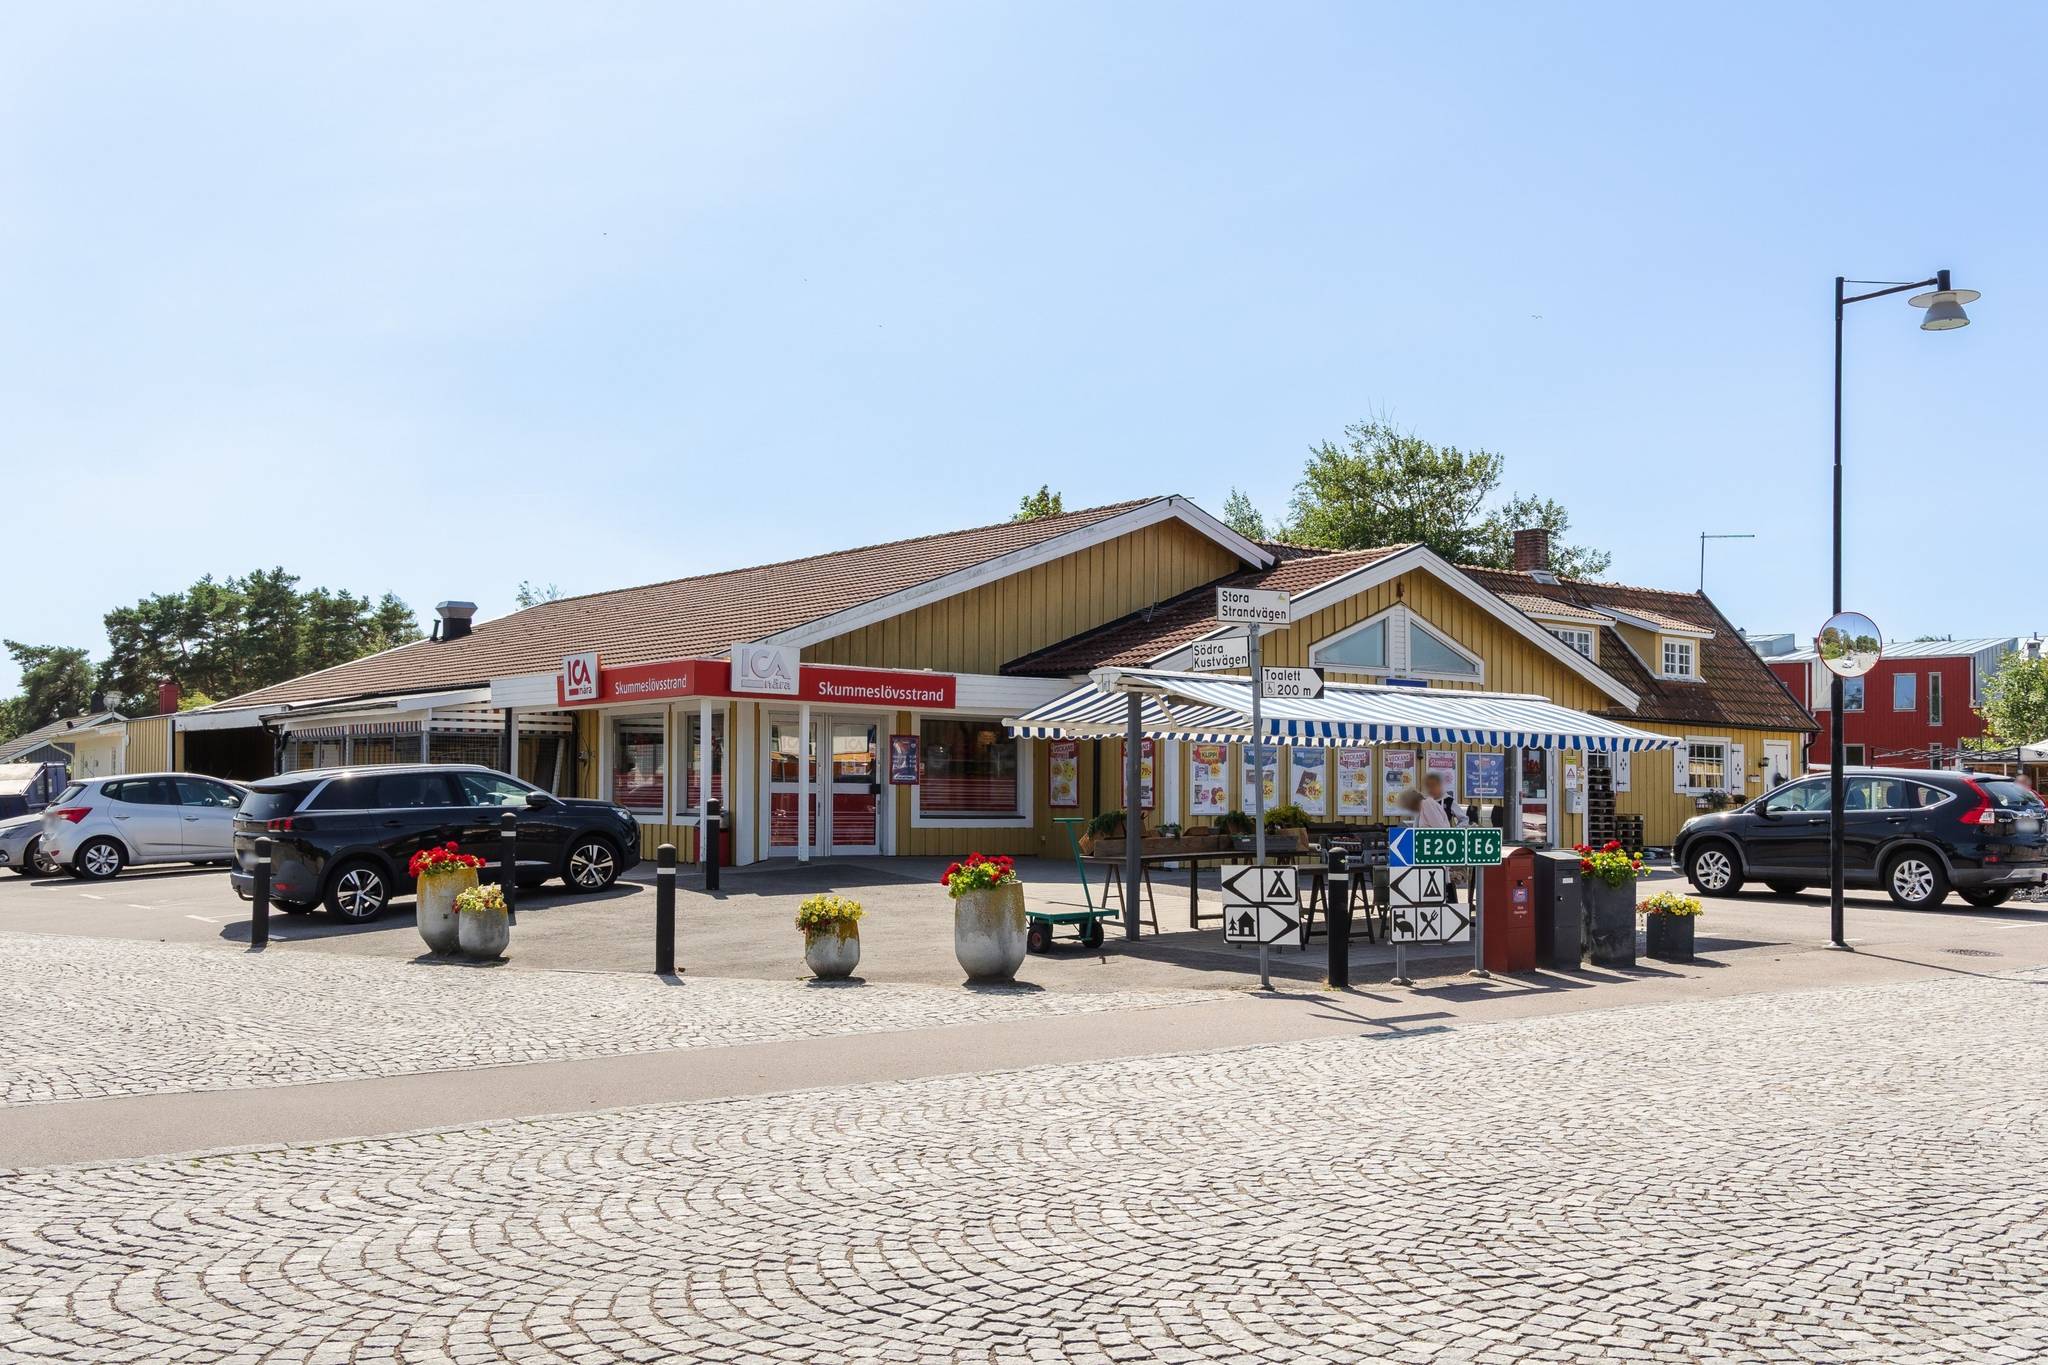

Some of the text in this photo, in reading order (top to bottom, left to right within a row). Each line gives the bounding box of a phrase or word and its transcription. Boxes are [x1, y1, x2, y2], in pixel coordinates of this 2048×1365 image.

[1222, 590, 1250, 604] Stora
[1222, 605, 1287, 621] Strandvägen
[1194, 644, 1224, 656] Södra
[741, 648, 792, 680] ICA
[1194, 654, 1247, 668] Kustvägen
[567, 659, 592, 687] ICA
[1264, 669, 1301, 681] Toalett
[579, 685, 593, 695] nära
[615, 674, 687, 695] Skummeslövsstrand
[764, 679, 791, 690] nära
[818, 681, 944, 702] Skummeslövsstrand
[1277, 684, 1311, 696] 200 m
[1423, 838, 1457, 855] E20
[1475, 838, 1494, 855] E6
